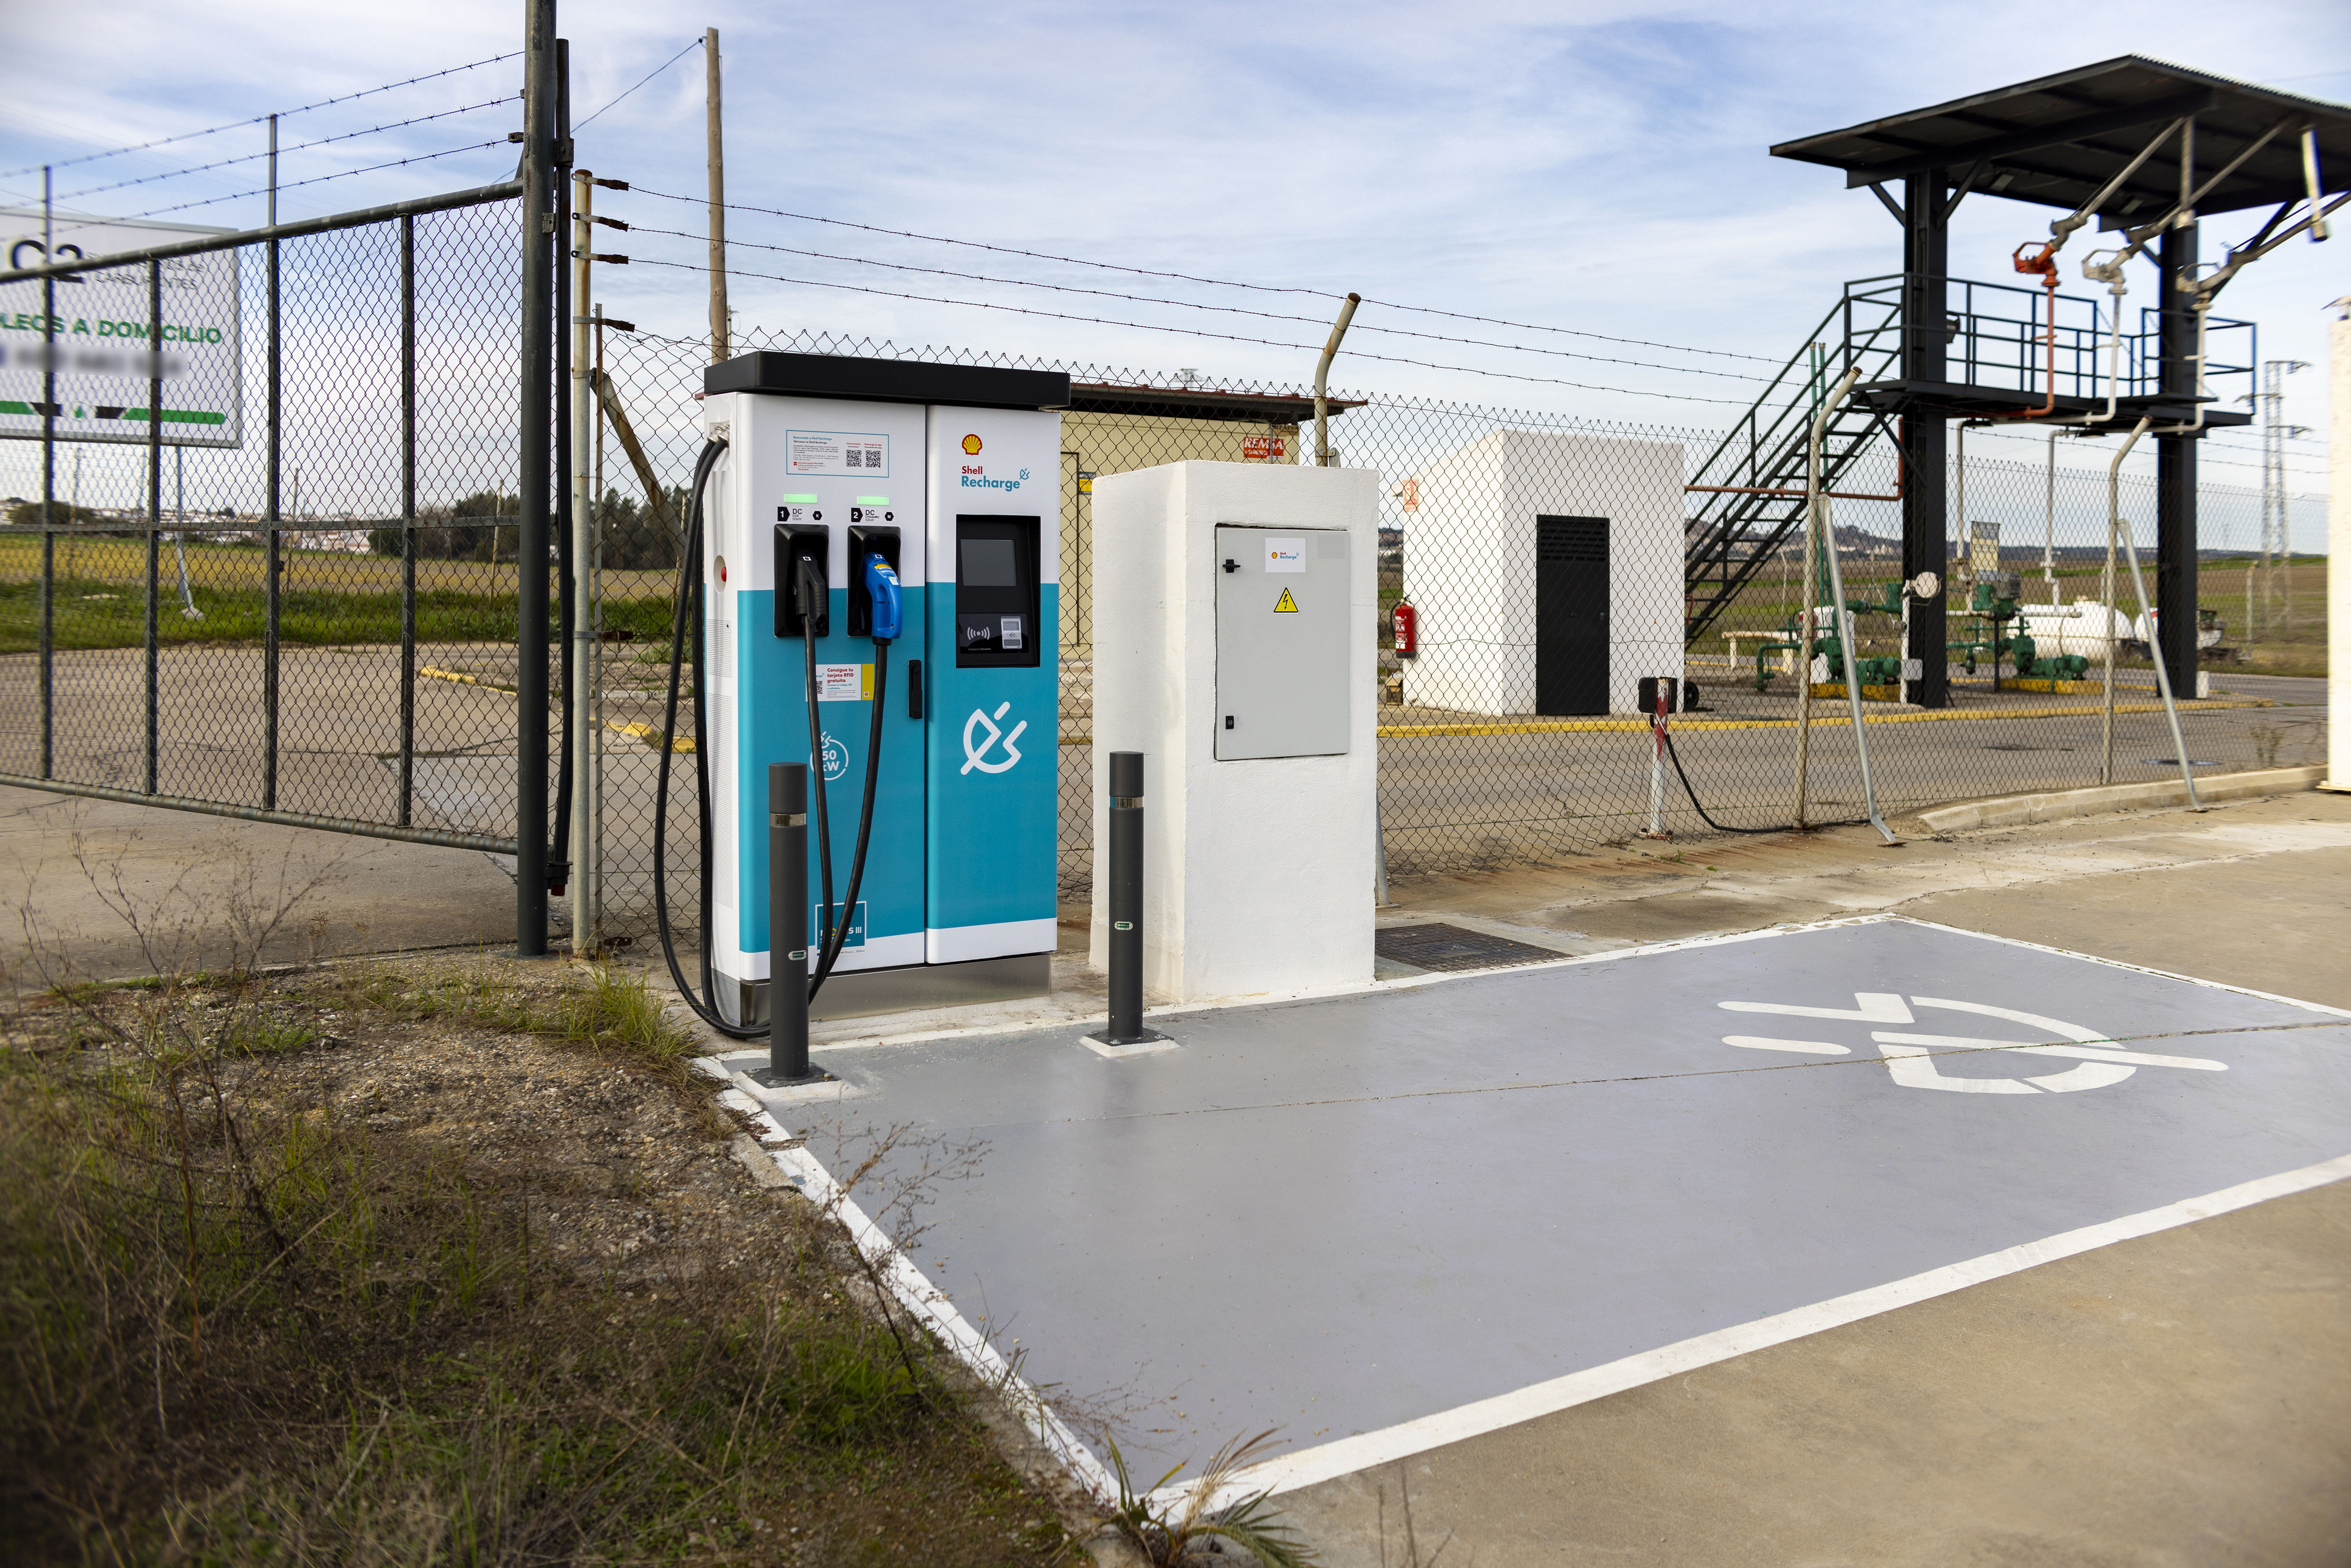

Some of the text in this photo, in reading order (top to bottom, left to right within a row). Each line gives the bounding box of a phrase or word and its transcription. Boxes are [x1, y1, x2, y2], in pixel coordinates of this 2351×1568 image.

[73, 318, 90, 335] A
[98, 320, 222, 344] DOMCILIO
[962, 465, 982, 474] Shell
[962, 476, 1020, 492] Recharge
[823, 750, 836, 760] 50
